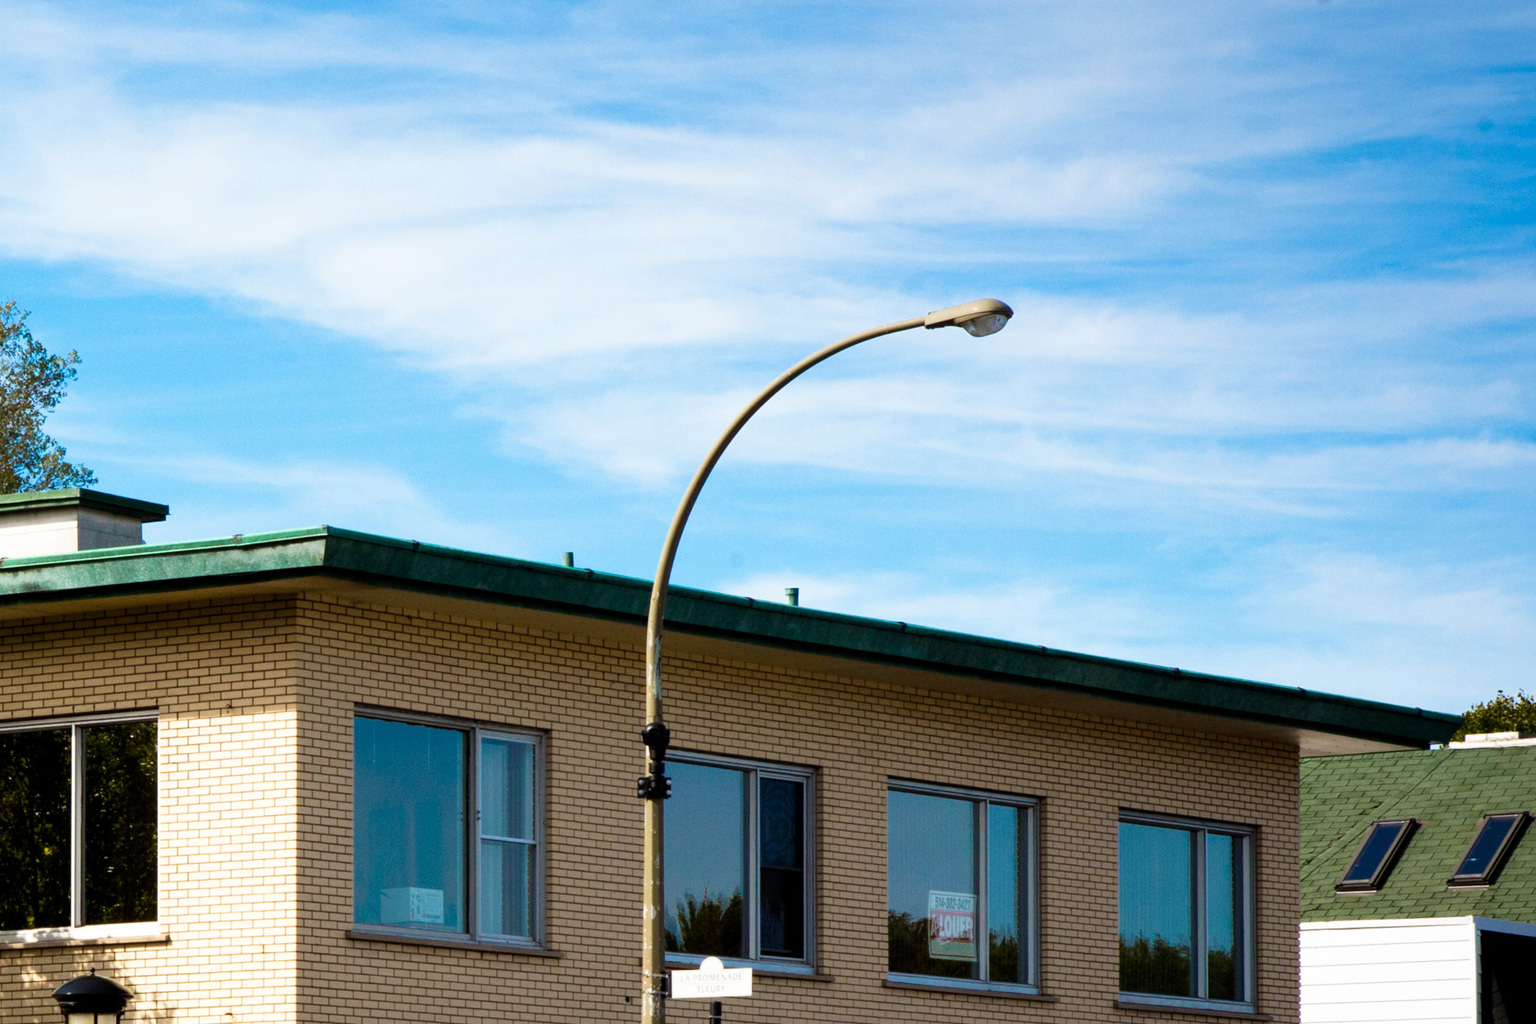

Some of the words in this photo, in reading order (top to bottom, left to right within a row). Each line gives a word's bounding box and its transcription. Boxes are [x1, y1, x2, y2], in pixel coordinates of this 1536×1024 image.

[939, 914, 973, 938] LOUER
[680, 974, 691, 982] LA
[693, 972, 743, 982] PROMENADE
[697, 985, 726, 993] FLEURY
